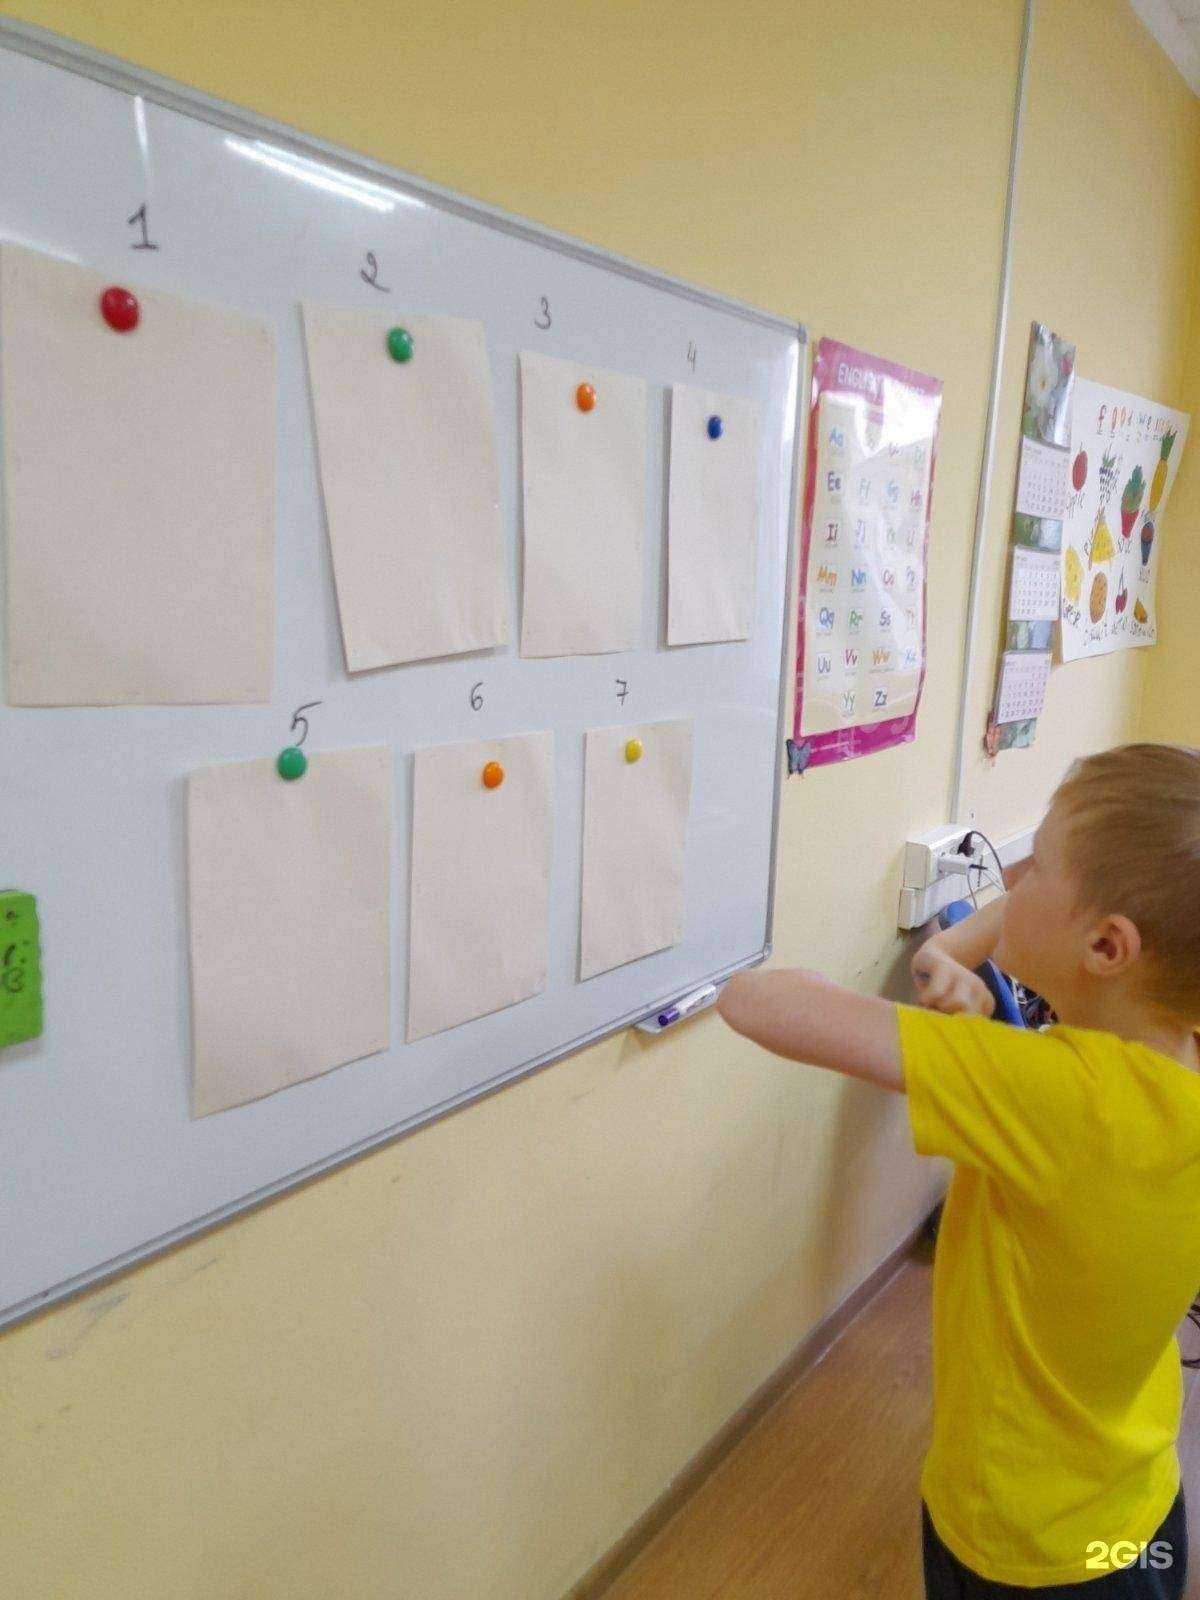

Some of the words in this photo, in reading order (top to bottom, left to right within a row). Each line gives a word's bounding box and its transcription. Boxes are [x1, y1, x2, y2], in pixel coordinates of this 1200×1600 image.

[127, 203, 160, 252] 1
[359, 251, 390, 293] 2
[534, 296, 552, 330] 3
[686, 341, 698, 372] 4
[828, 470, 842, 491] Ee
[817, 565, 838, 587] Mm
[851, 568, 867, 587] Nn
[820, 606, 835, 630] Qq
[879, 608, 892, 627] Ss
[817, 656, 832, 675] Uu
[844, 647, 859, 667] Vv
[470, 681, 484, 712] 6
[614, 678, 631, 707] 7
[841, 691, 855, 713] Yy
[873, 690, 888, 708] Zz
[289, 700, 323, 748] 5
